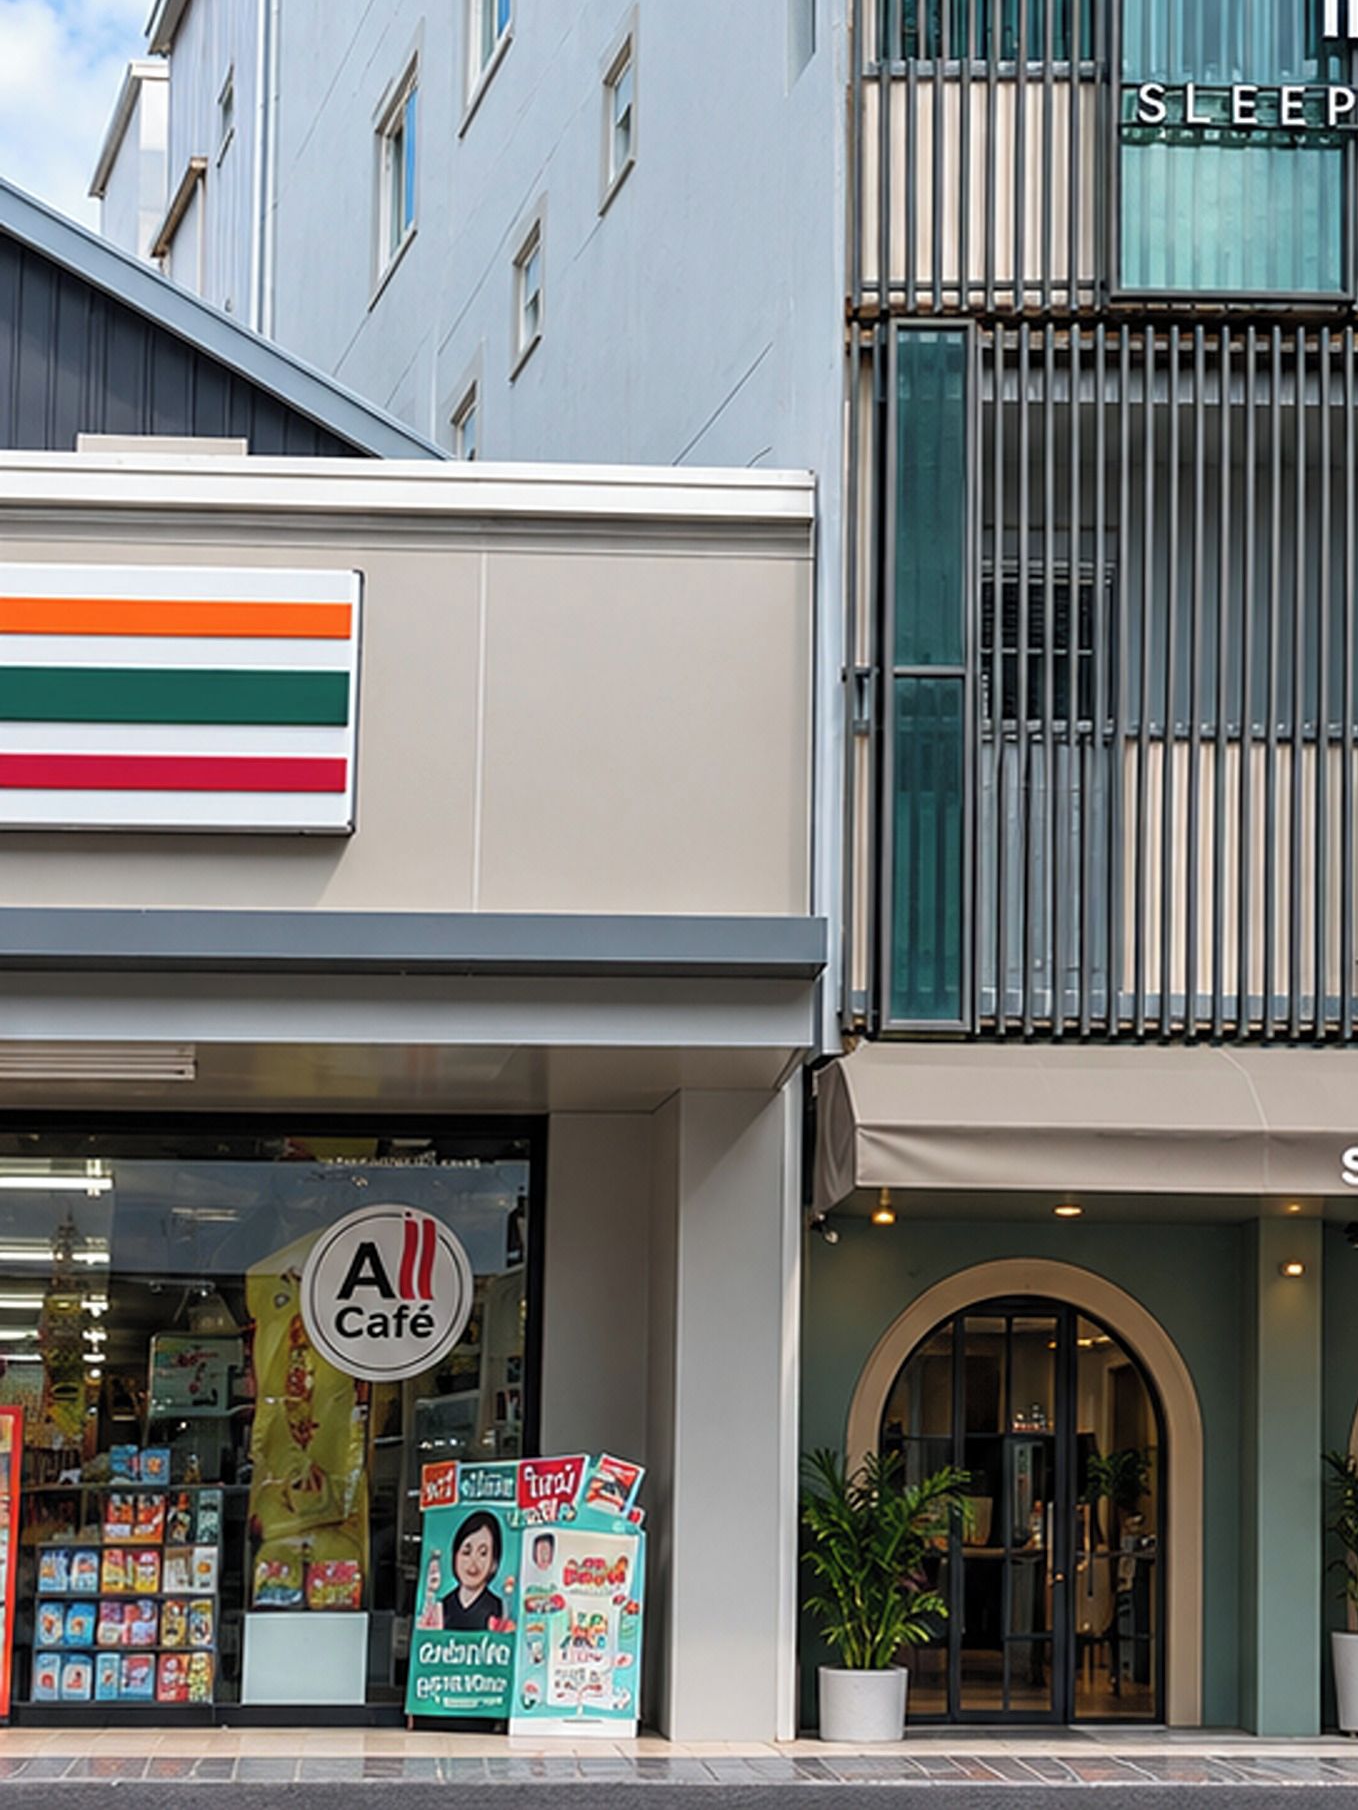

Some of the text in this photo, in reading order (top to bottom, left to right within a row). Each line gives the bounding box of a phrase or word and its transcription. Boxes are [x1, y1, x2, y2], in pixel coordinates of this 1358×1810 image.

[1137, 84, 1355, 127] SLEEP
[336, 1218, 436, 1300] All
[335, 1304, 434, 1338] Café
